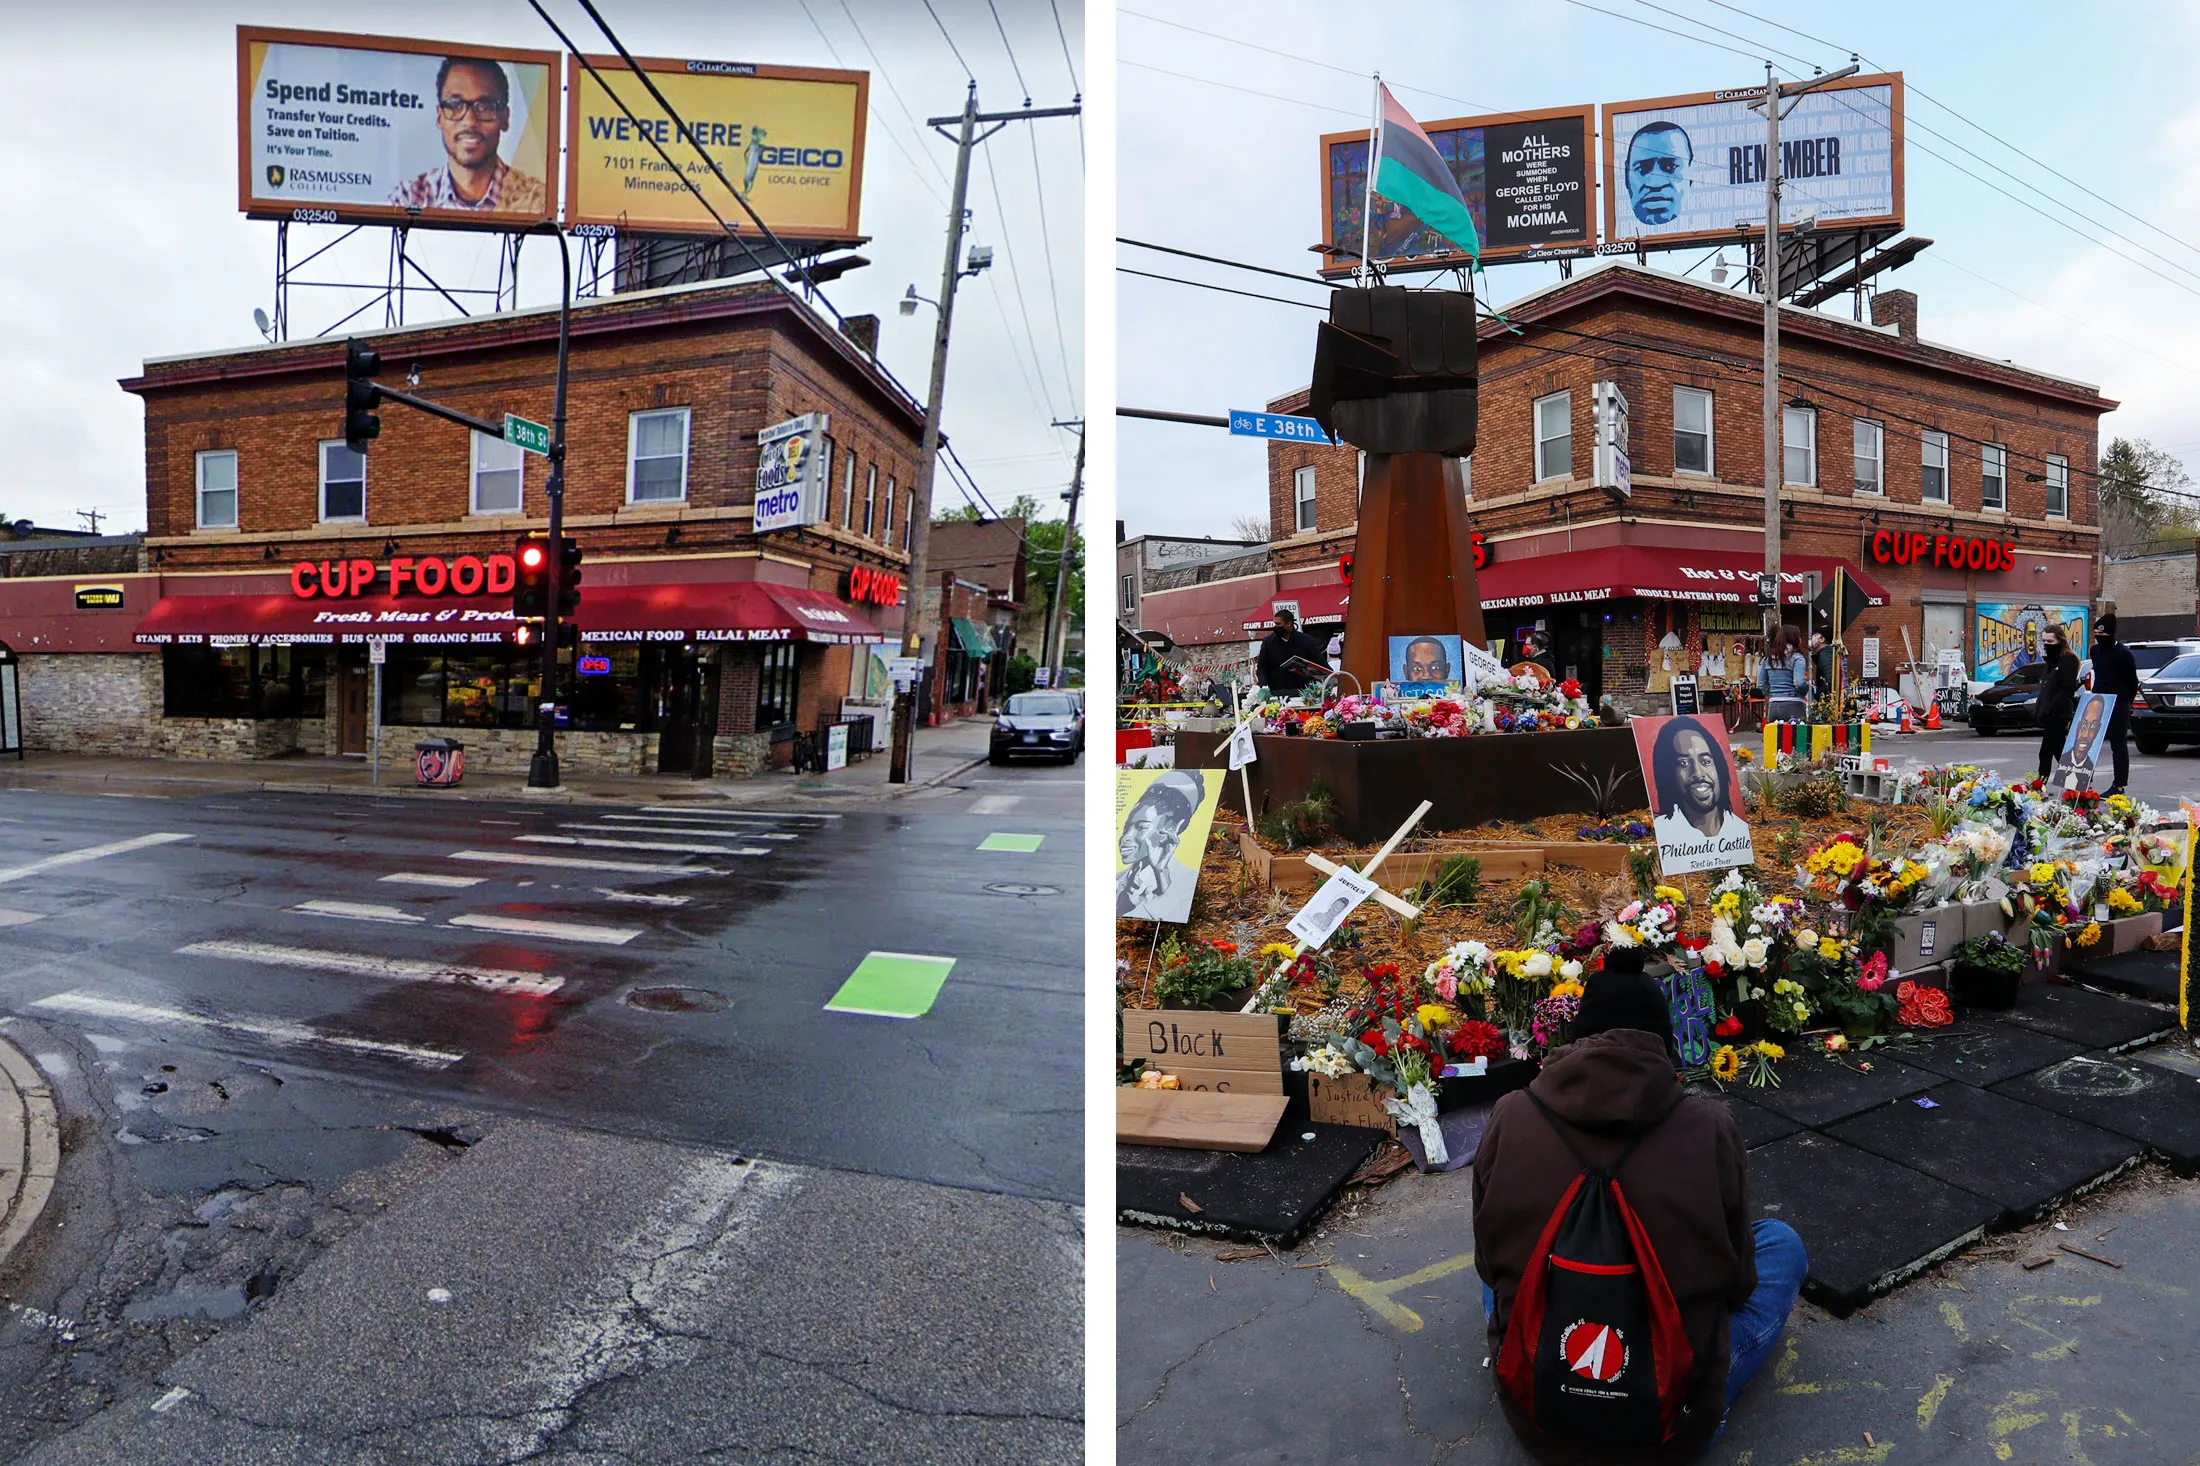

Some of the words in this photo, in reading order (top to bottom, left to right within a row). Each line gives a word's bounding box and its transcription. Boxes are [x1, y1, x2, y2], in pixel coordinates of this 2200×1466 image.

[266, 79, 330, 104] Spend
[336, 83, 424, 109] Smarter.
[267, 108, 315, 123] Transfer
[318, 111, 344, 125] Your
[346, 113, 390, 127] Credits.
[267, 124, 295, 138] Save
[298, 128, 312, 139] on
[315, 128, 359, 142] Tuition.
[588, 116, 669, 143] WE'RE
[676, 122, 742, 147] HERE
[1522, 134, 1550, 148] ALL
[267, 144, 282, 155] It's
[284, 145, 305, 156] Your
[307, 147, 333, 158] Time.
[758, 147, 843, 168] GEICO
[1502, 145, 1571, 163] MOTHERS
[604, 155, 635, 169] 7101
[687, 160, 711, 174] Ave
[1526, 160, 1547, 169] WERE
[1729, 136, 1841, 185] REMMBER
[290, 168, 372, 185] RASMUSSEN
[1516, 167, 1558, 177] SUMMONED
[624, 176, 701, 193] Minneapolis
[768, 175, 796, 186] LOCAL
[799, 176, 831, 187] OFFICE
[1496, 184, 1541, 198] GEORGE
[1544, 181, 1579, 193] FLOYD
[1515, 195, 1543, 204] CALLED
[1544, 193, 1560, 202] OUT
[1523, 203, 1539, 212] FOR
[1539, 202, 1552, 211] HIS
[293, 208, 337, 222] 032540
[1507, 210, 1568, 228] MOMMA
[575, 225, 616, 236] 032570
[1536, 249, 1554, 257] Clear
[1554, 247, 1579, 256] Channel
[1597, 242, 1636, 255] 032570
[507, 422, 513, 437] E
[516, 424, 535, 445] 38th
[538, 432, 547, 448] St
[1256, 418, 1267, 433] E
[1274, 419, 1315, 437] 38th
[757, 489, 799, 518] metro
[1872, 529, 1927, 565] CUP
[1934, 535, 2016, 571] FOODS
[291, 558, 376, 599] CUP
[1679, 566, 1719, 580] Hot
[1720, 569, 1736, 581] &
[850, 564, 870, 601] CUP
[869, 570, 901, 607] FOODS
[1479, 598, 1518, 610] MEXICAN
[1519, 595, 1544, 607] FOOD
[1550, 591, 1583, 603] HALAL
[1584, 588, 1612, 600] MEAT
[1633, 587, 1671, 599] MIDDLE
[1672, 590, 1715, 601] EASTERN
[1715, 592, 1740, 602] FOOD
[313, 611, 373, 623] Fresh
[376, 609, 432, 622] Meat
[435, 608, 458, 621] &
[1304, 614, 1342, 626] ACCESSORIES
[1243, 621, 1262, 631] STAMPS
[135, 634, 172, 643] STAMPS
[178, 634, 203, 643] KEYS
[209, 634, 249, 643] PHONES
[250, 634, 258, 643] &
[261, 633, 334, 643] ACCESSORIES
[342, 633, 364, 643] BUS
[366, 633, 404, 643] CARDS
[413, 633, 468, 643] ORGANIC
[470, 633, 502, 642] MILK
[580, 630, 644, 642] MEXICAN
[646, 630, 685, 641] FOOD
[695, 629, 744, 641] HALAL
[747, 628, 791, 641] MEAT
[1979, 614, 2023, 666] GEORGE
[583, 660, 607, 670] OPEN
[1469, 651, 1496, 675] GEORGE
[1936, 689, 1949, 701] SAY
[1940, 702, 1960, 714] NAME
[1660, 840, 1715, 860] Philando
[1718, 836, 1751, 853] Castile
[1690, 860, 1705, 870] Rest
[1706, 859, 1713, 867] in
[1714, 857, 1732, 866] Power
[1148, 1020, 1224, 1057] Black
[1324, 1085, 1369, 1102] Justice
